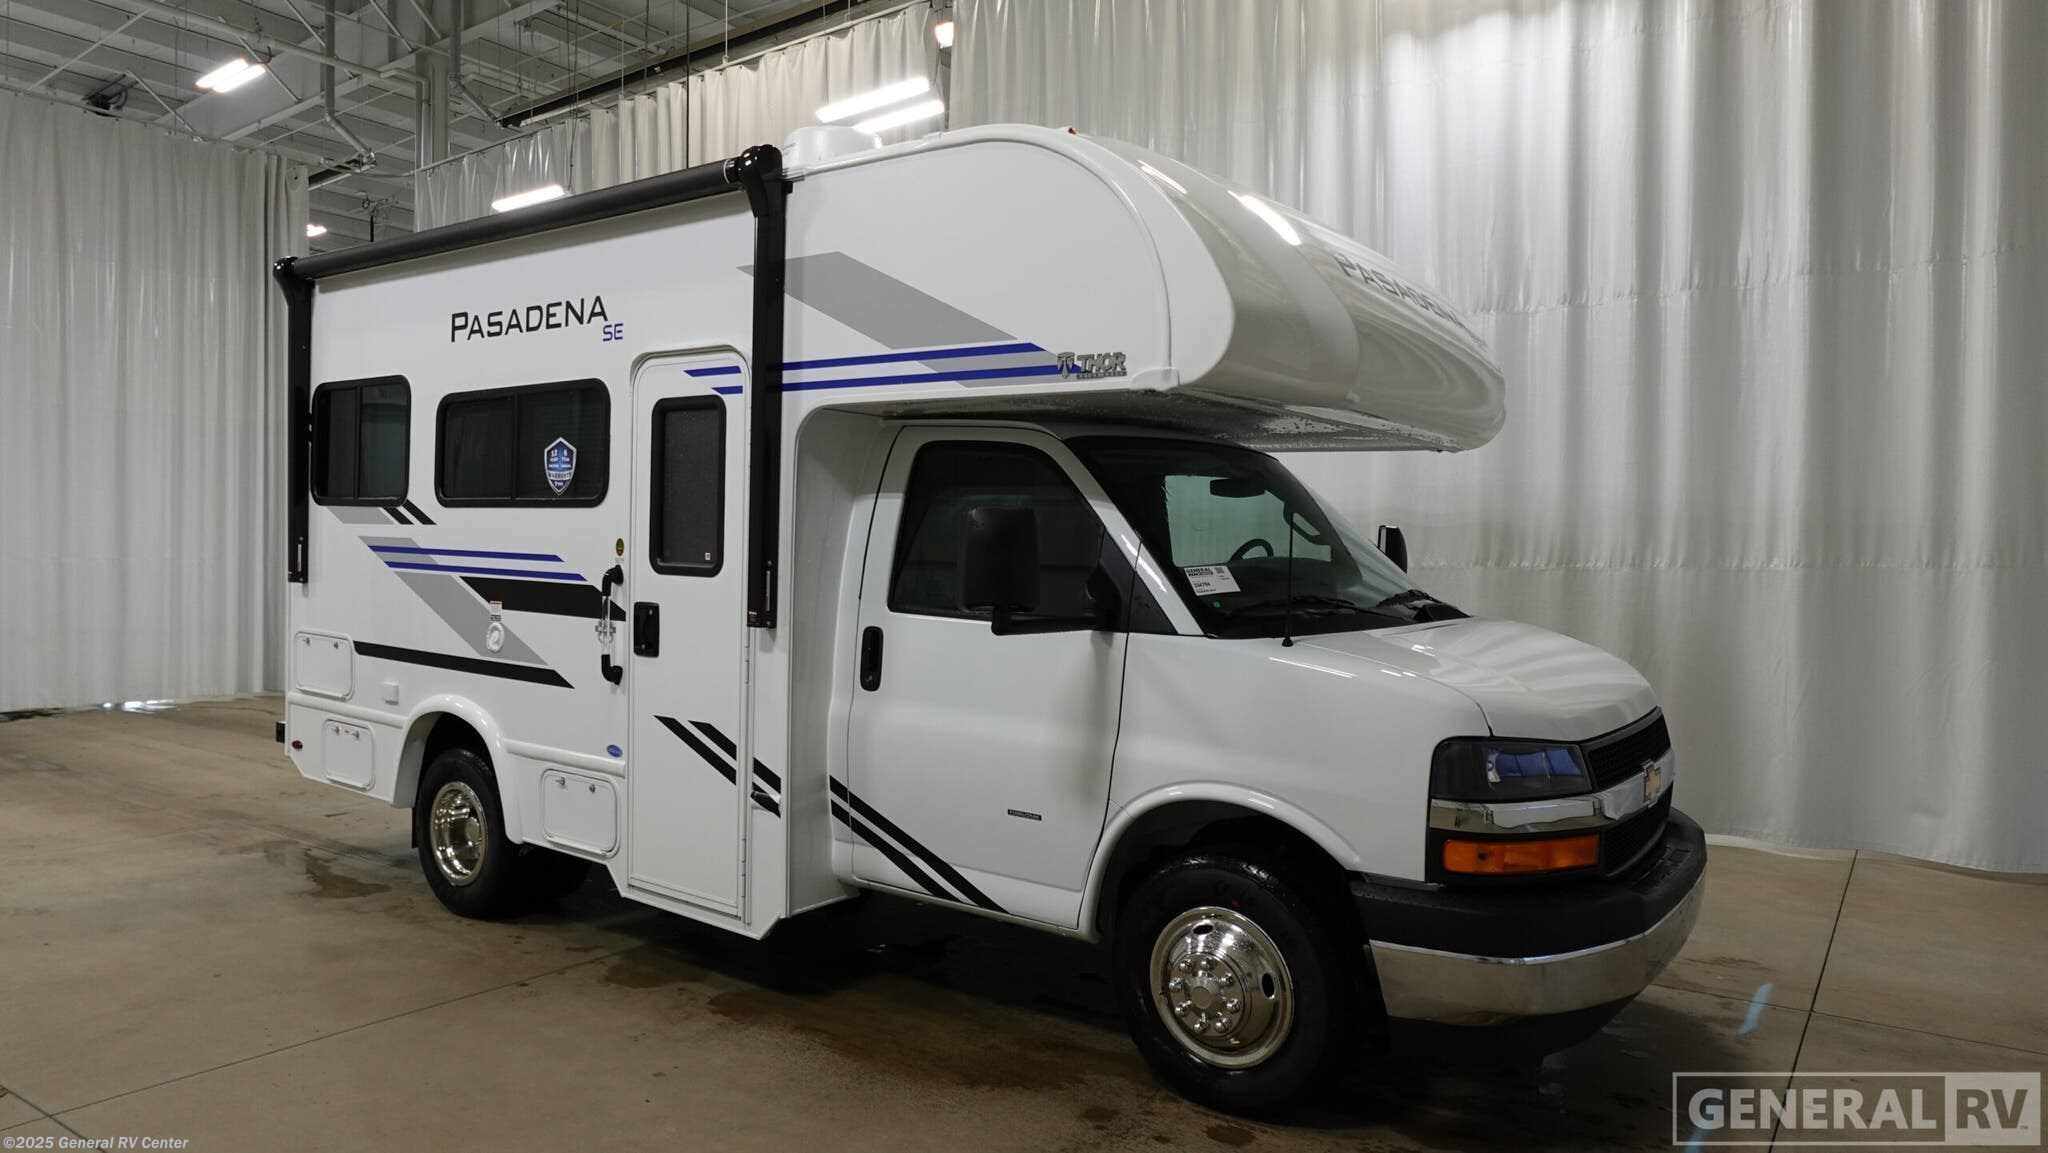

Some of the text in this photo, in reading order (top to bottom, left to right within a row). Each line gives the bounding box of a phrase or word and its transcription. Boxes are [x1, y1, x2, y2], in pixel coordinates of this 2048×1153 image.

[451, 295, 609, 343] PASADENA
[602, 322, 624, 342] SE
[1076, 352, 1126, 374] THOR
